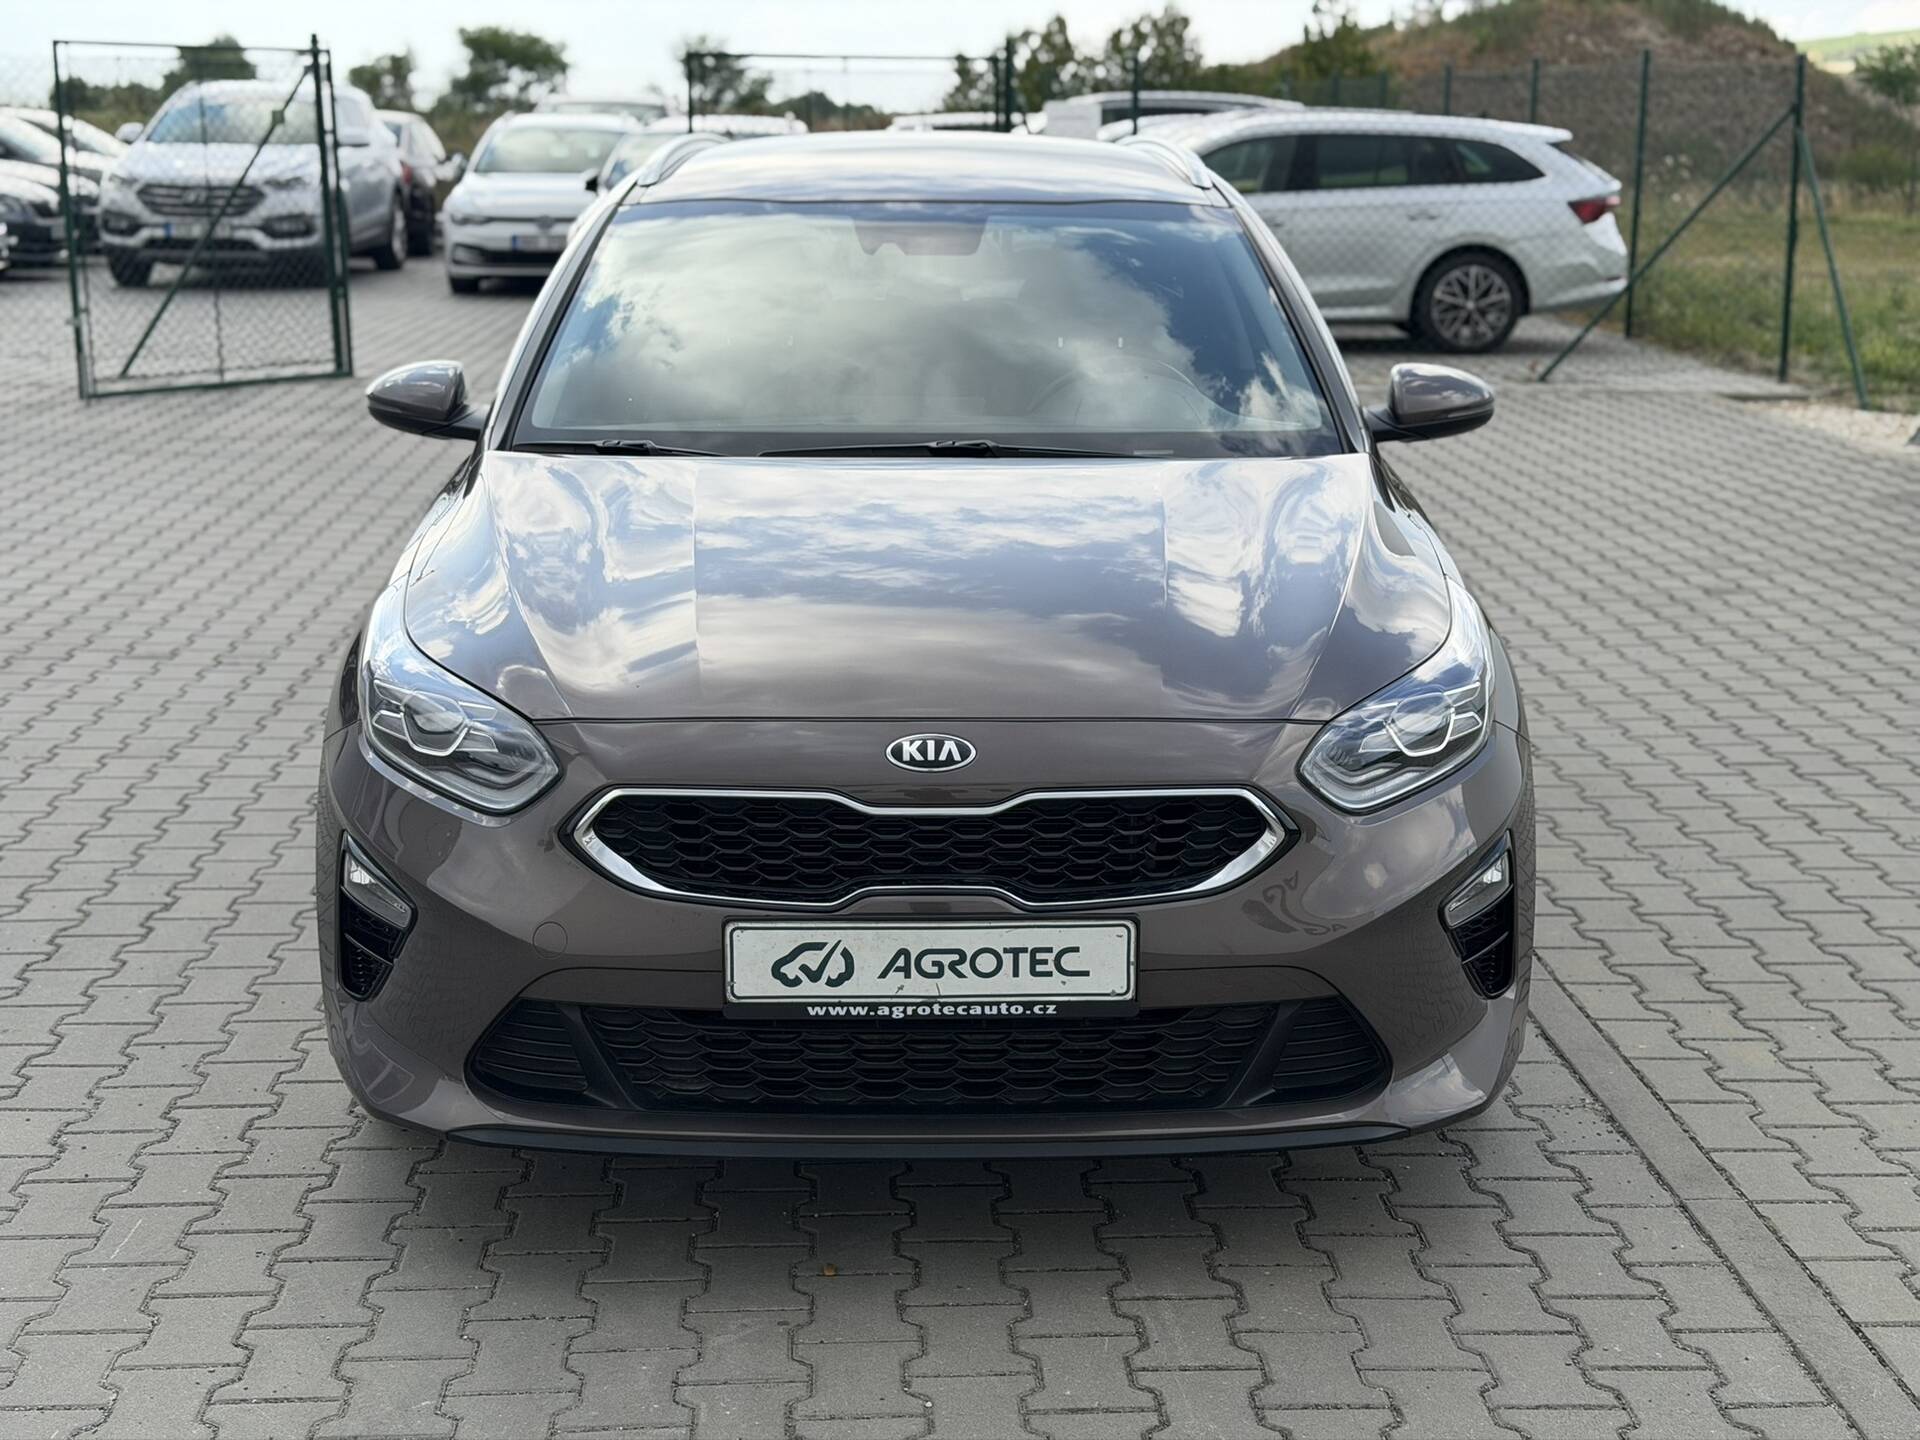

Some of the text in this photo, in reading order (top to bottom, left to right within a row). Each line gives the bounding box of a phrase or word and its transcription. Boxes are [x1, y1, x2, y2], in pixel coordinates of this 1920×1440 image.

[901, 739, 962, 761] KIA
[877, 946, 1091, 980] AGROTEC
[807, 1003, 1057, 1018] www.agrotecauto.cz
